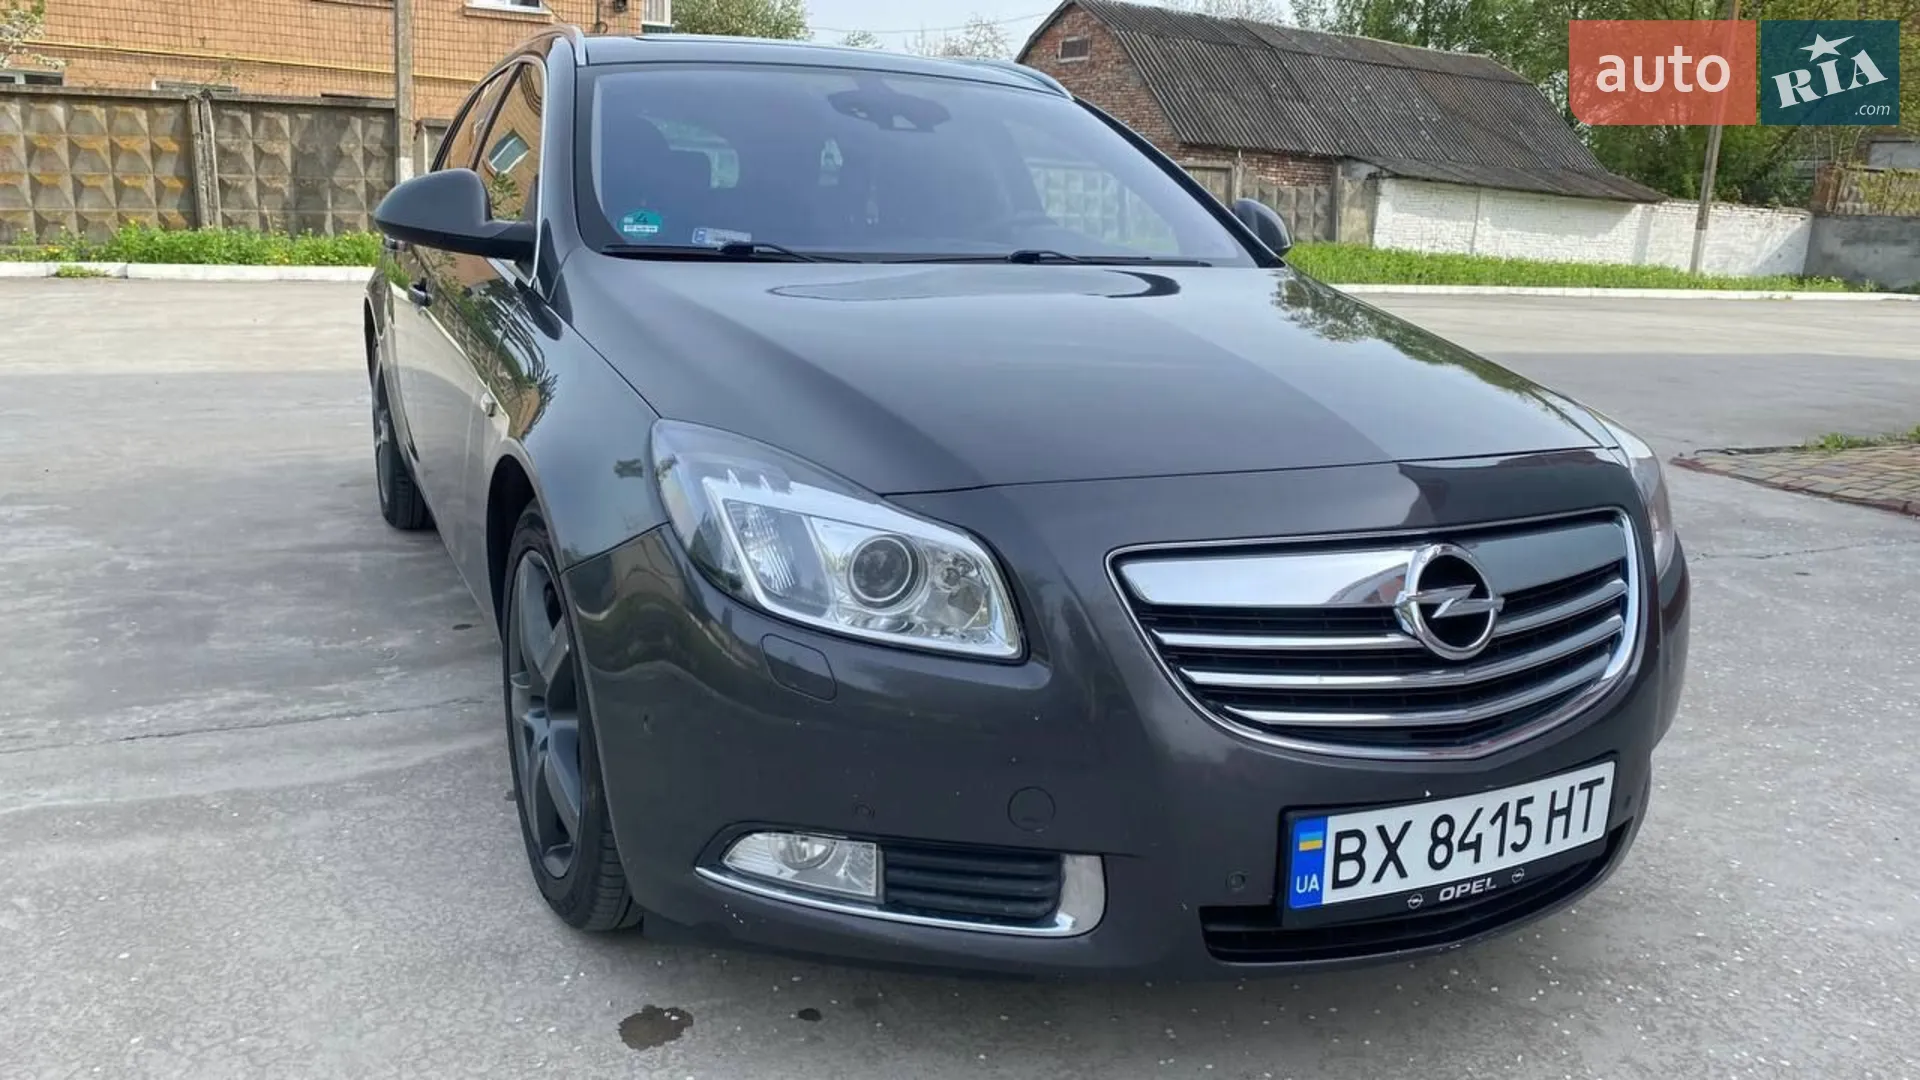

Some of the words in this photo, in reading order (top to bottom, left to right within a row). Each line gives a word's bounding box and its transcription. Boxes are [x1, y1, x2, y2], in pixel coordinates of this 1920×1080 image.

[1331, 820, 1412, 889] BX
[1427, 796, 1535, 871] 8415
[1545, 778, 1604, 845] HT
[1296, 875, 1319, 894] UA
[1438, 877, 1496, 902] OPEL
